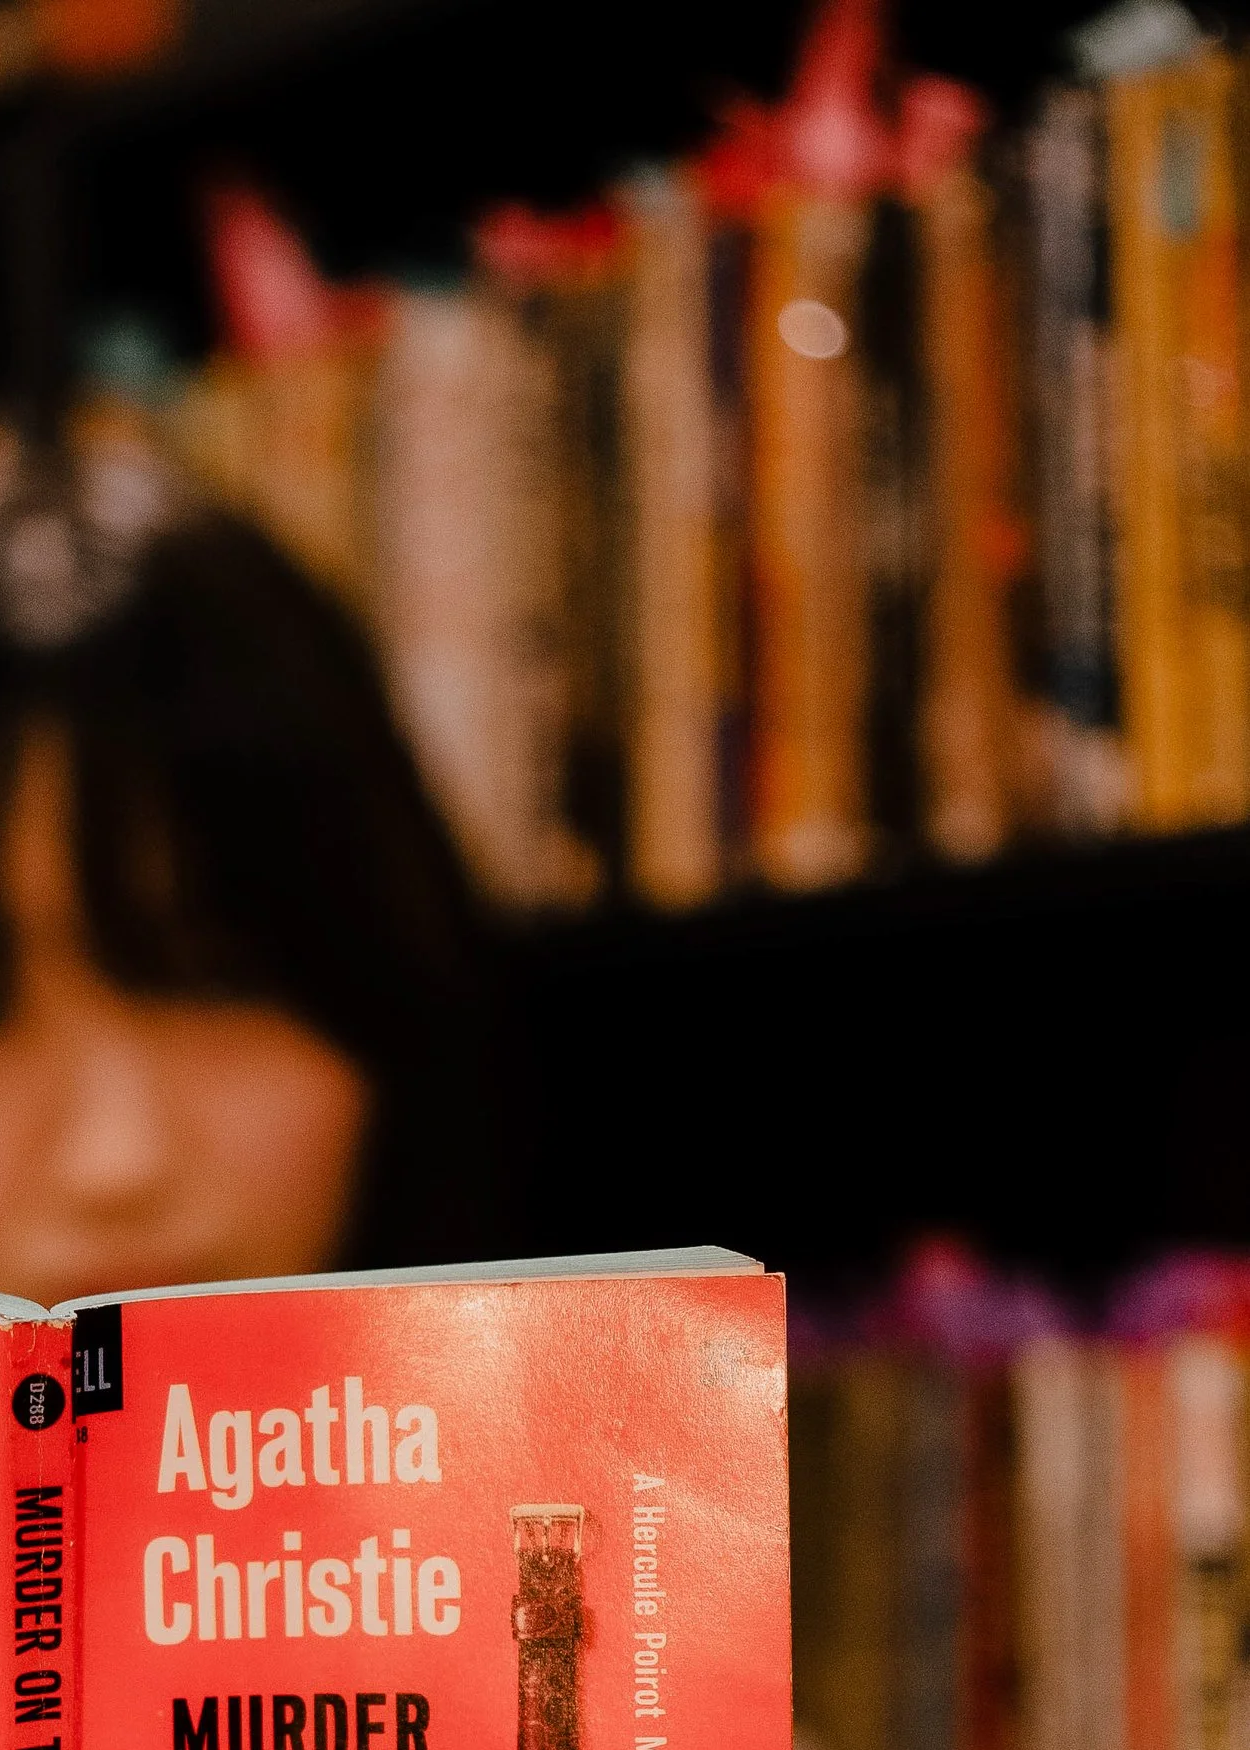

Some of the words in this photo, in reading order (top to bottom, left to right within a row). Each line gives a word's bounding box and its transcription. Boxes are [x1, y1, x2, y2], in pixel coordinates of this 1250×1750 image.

[30, 1382, 46, 1425] D288
[157, 1377, 443, 1510] Agatha
[633, 1472, 666, 1493] A
[14, 1485, 63, 1657] MURDER
[144, 1529, 461, 1645] Christie
[633, 1505, 667, 1617] Hercule
[14, 1671, 62, 1724] ON
[634, 1632, 668, 1719] Poirot
